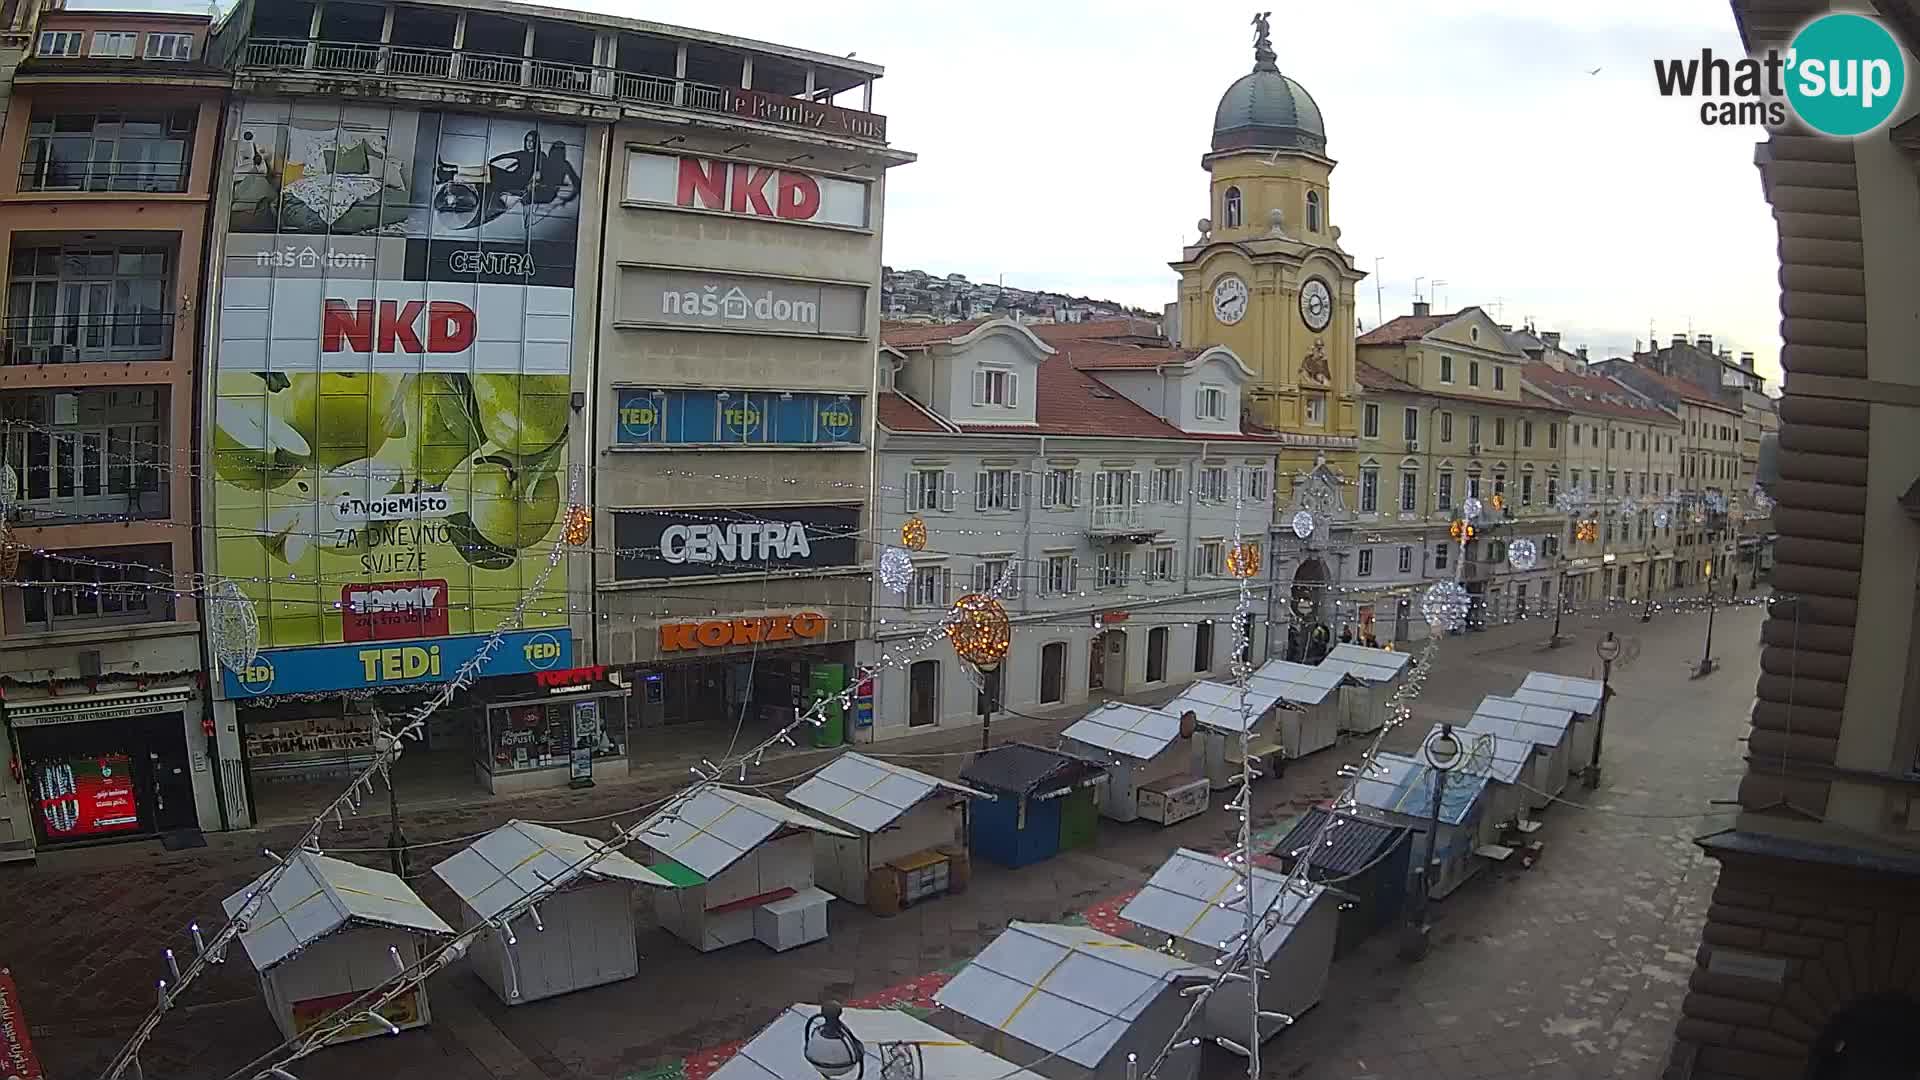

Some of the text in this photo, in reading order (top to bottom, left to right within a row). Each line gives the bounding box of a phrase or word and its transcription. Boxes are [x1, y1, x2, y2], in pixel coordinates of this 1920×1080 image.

[677, 157, 821, 221] NKD
[256, 246, 368, 269] naš dom
[449, 249, 536, 276] CENTRA
[662, 284, 817, 323] naš dom
[322, 298, 478, 354] NKD
[619, 408, 658, 426] TEDi
[723, 408, 761, 427] TEDi
[821, 411, 853, 427] TEDi
[339, 496, 448, 517] #TvojeMisto
[335, 524, 451, 549] ZA DNEVNO
[659, 520, 811, 564] CENTRA
[360, 546, 428, 575] SVJEŽE
[659, 611, 826, 652] KORZO
[359, 645, 441, 682] TEDi
[523, 643, 561, 660] TEDi
